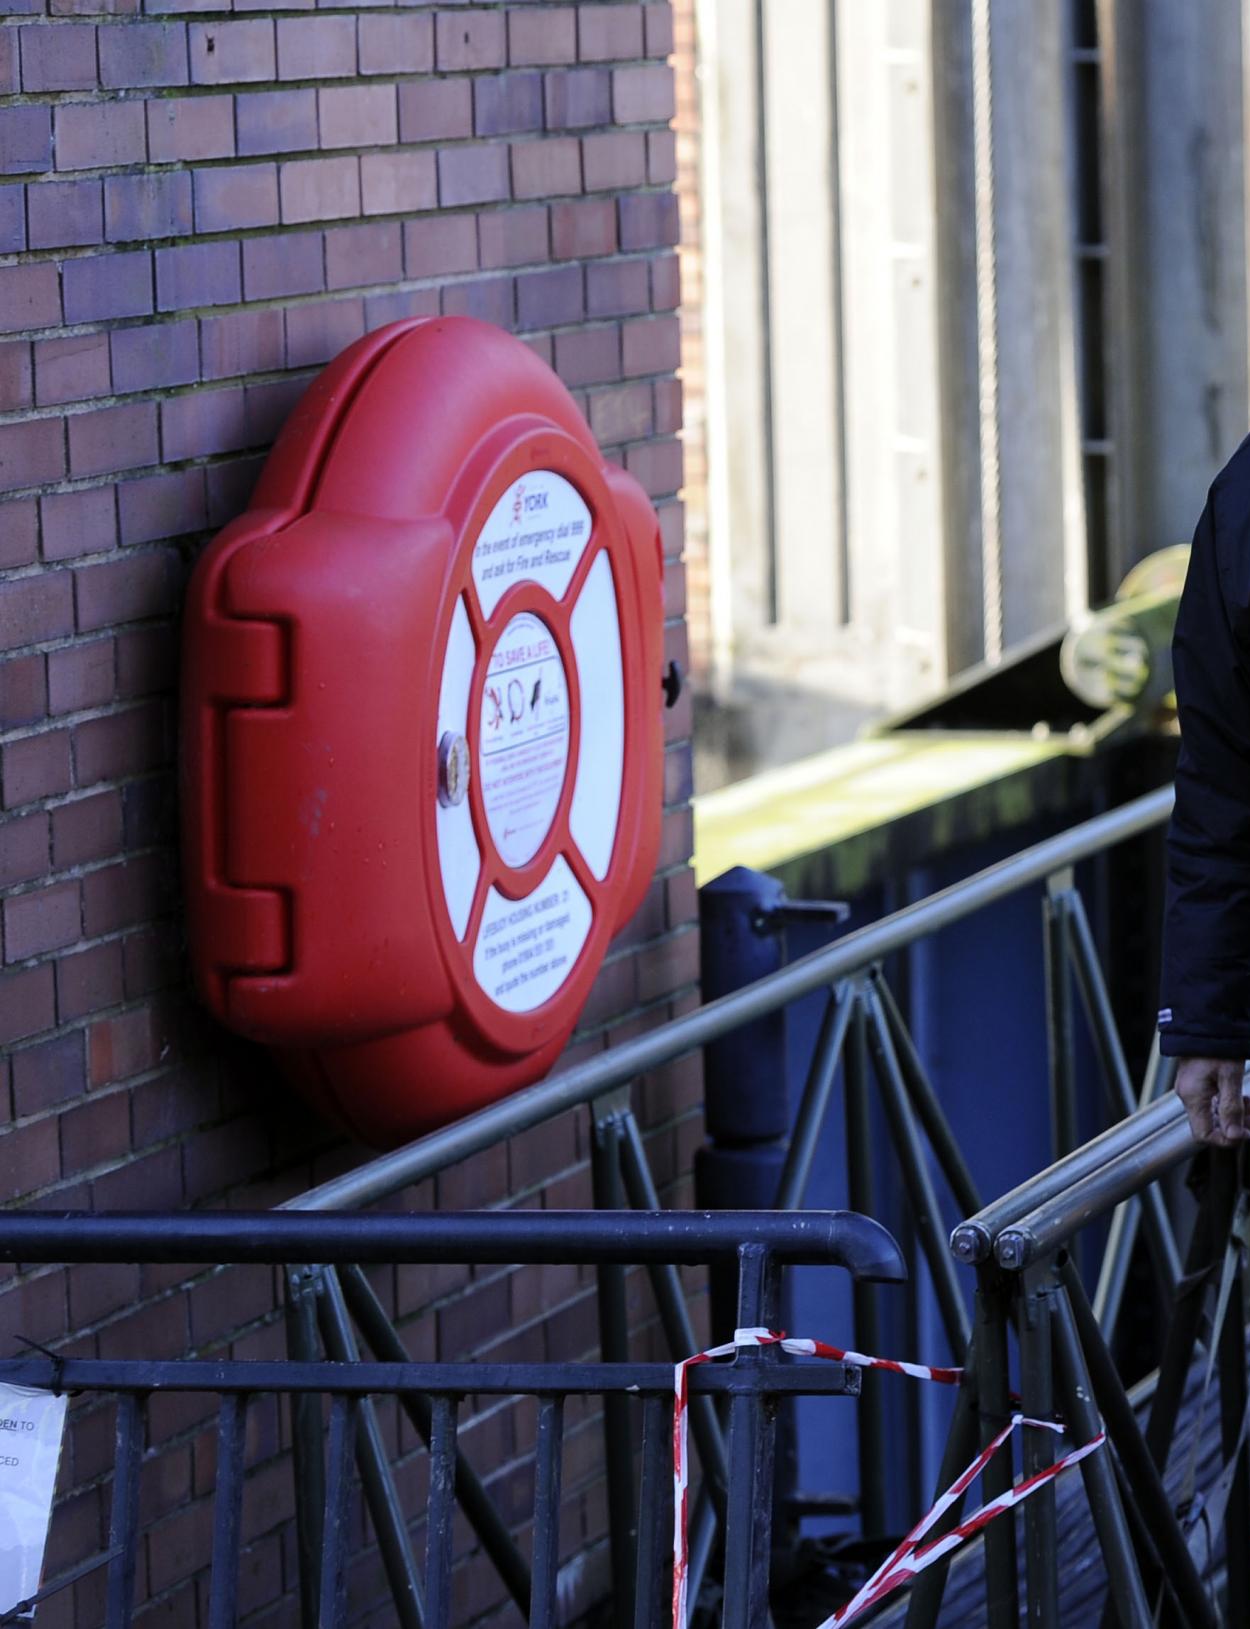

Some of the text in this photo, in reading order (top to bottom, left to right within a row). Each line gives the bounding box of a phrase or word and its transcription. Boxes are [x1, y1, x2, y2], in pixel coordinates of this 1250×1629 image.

[524, 492, 548, 512] YORK
[482, 542, 492, 557] the
[492, 535, 511, 553] event
[511, 532, 518, 549] of
[519, 529, 555, 548] emergency
[557, 522, 570, 540] dial
[481, 548, 571, 581] and ask for Fire and Rescue
[506, 647, 525, 666] SAVE
[517, 928, 537, 945] missing
[545, 914, 571, 932] damaged
[529, 963, 548, 978] number
[21, 1420, 35, 1431] TO
